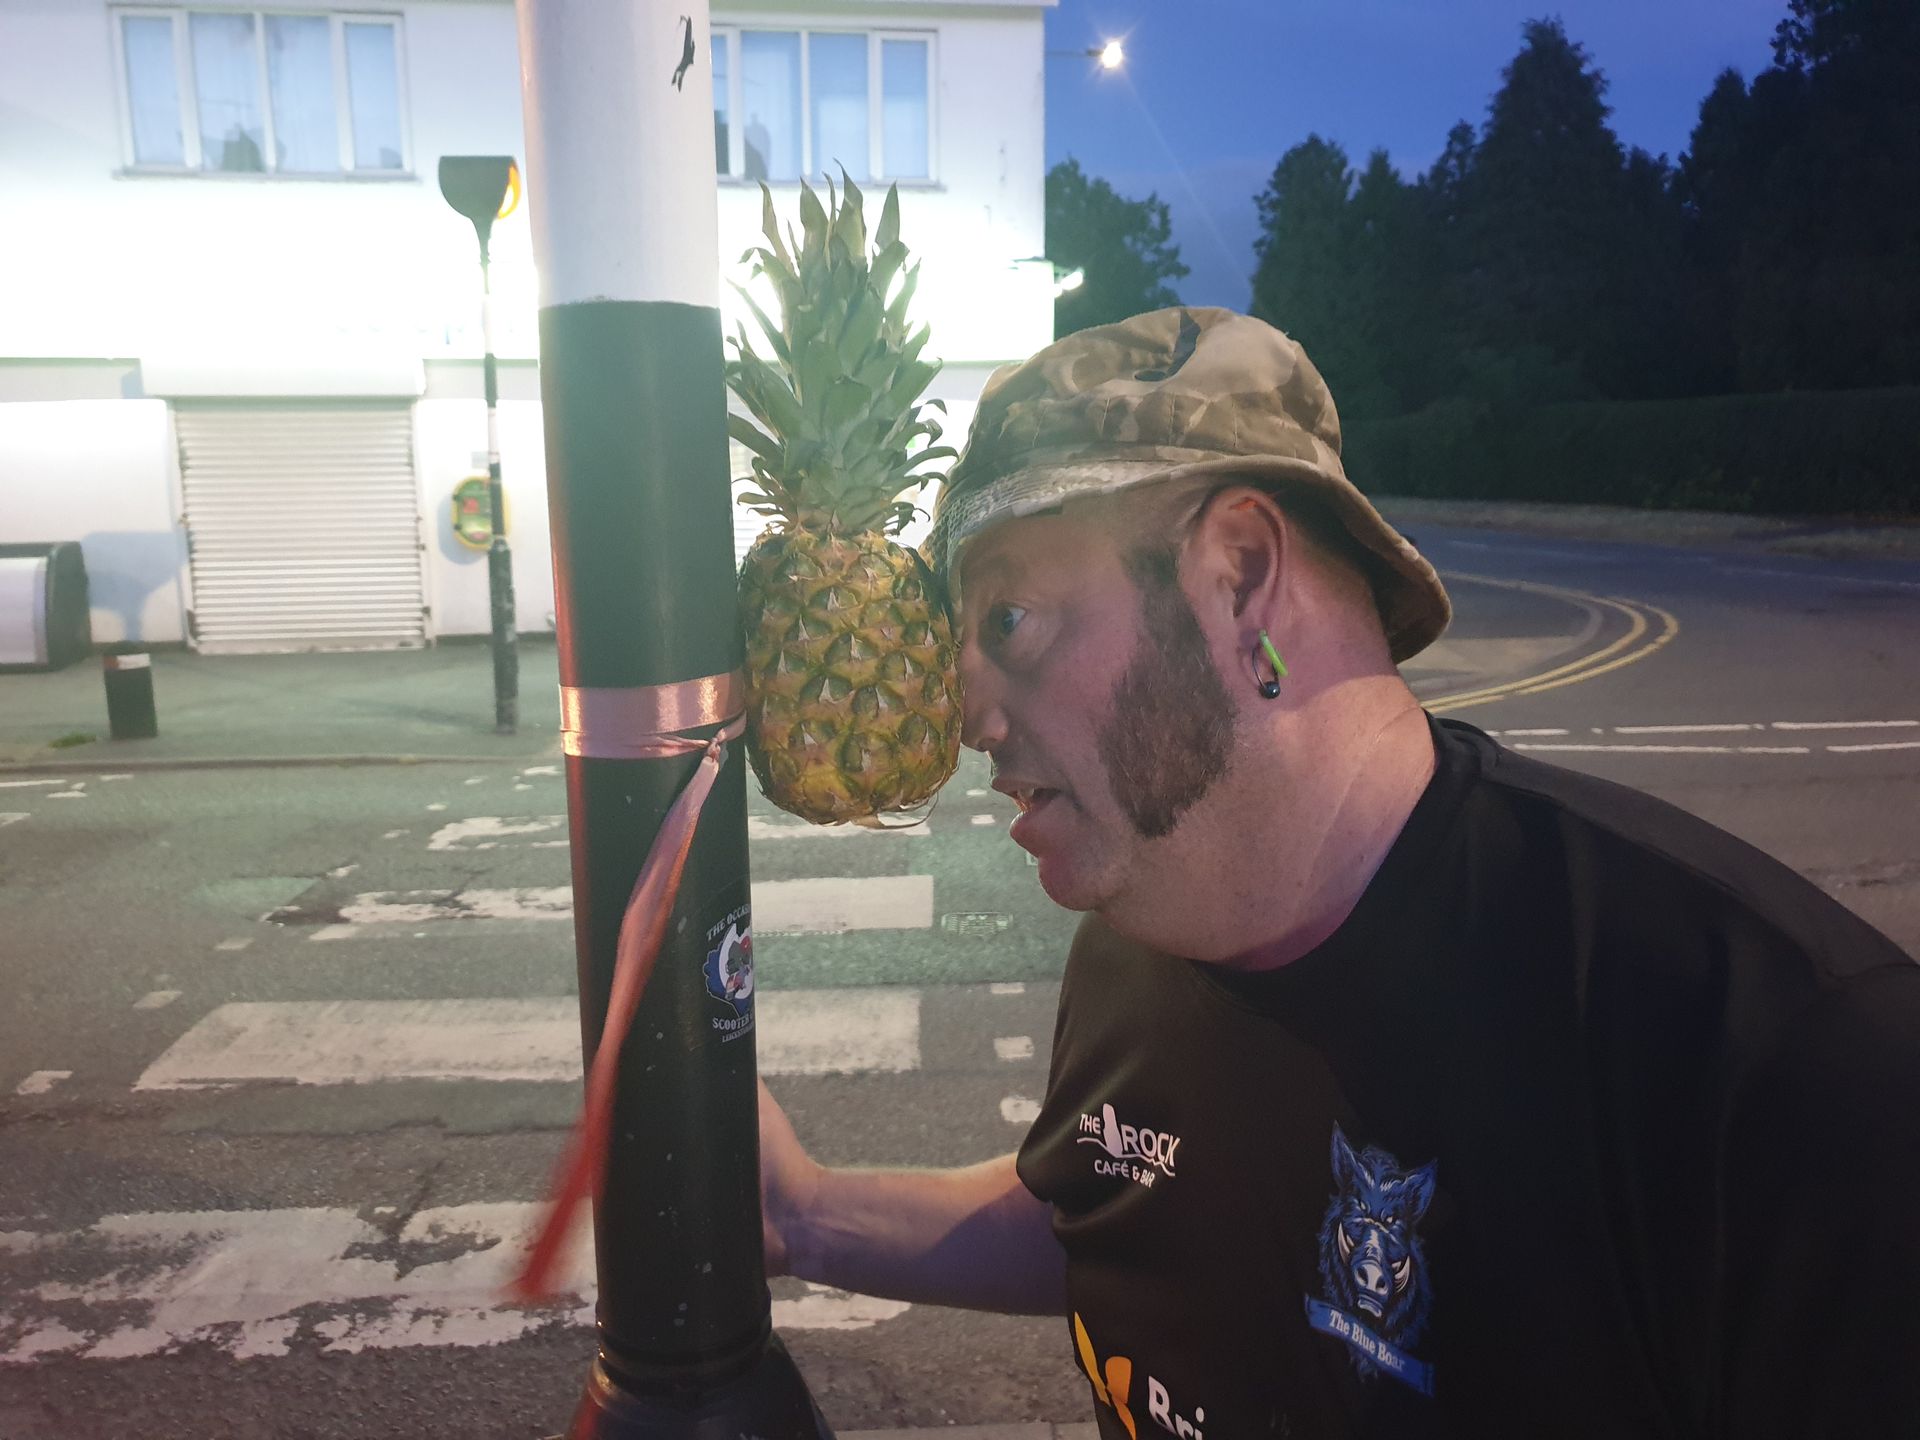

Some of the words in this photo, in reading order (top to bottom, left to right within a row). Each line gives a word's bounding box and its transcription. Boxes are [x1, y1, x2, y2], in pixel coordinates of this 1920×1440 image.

[706, 918, 726, 941] THE
[712, 1013, 750, 1030] SCOOTER
[1080, 1113, 1101, 1135] THE
[1120, 1124, 1181, 1167] ROCK
[1094, 1160, 1130, 1178] CAFÉ
[1132, 1166, 1140, 1181] &
[1139, 1169, 1156, 1188] BAR
[1329, 1309, 1350, 1335] The
[1351, 1323, 1376, 1354] Blue
[1377, 1342, 1405, 1372] Boar
